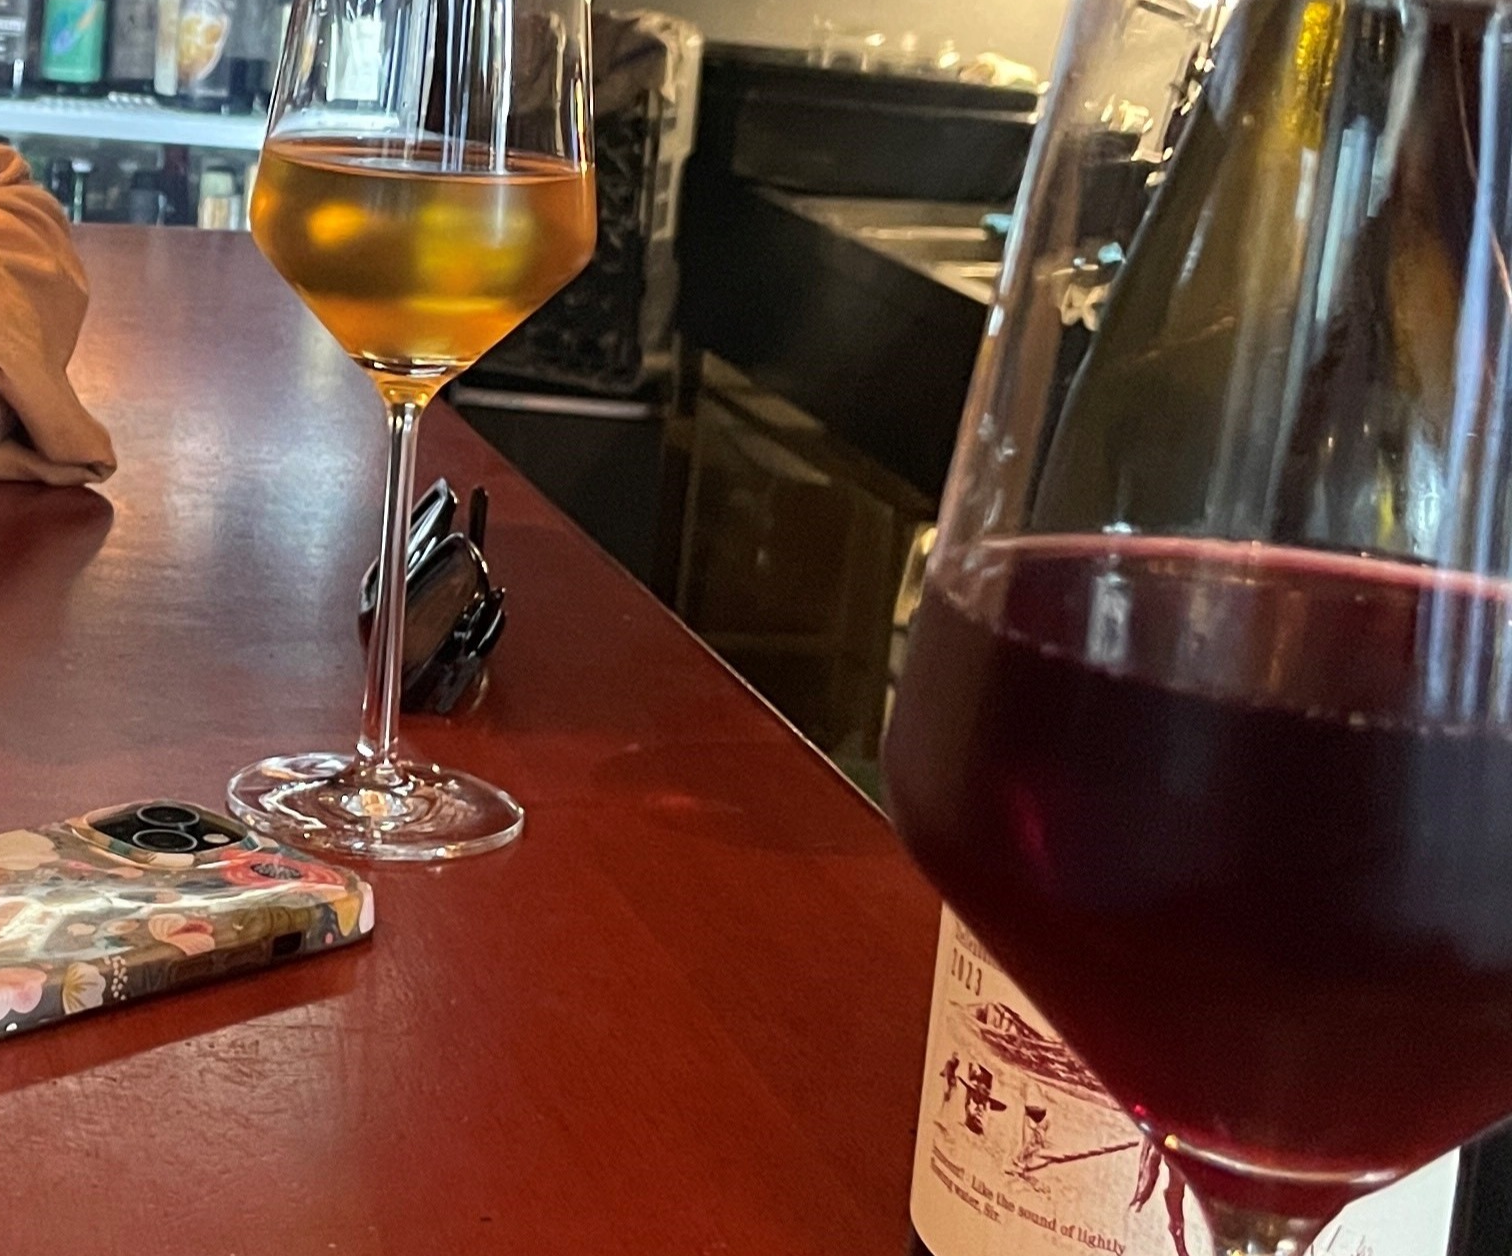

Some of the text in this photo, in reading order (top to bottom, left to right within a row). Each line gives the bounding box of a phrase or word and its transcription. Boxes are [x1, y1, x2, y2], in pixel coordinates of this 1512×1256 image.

[1018, 1206, 1057, 1233] sound
[1060, 1224, 1076, 1239] of
[1077, 1226, 1126, 1256] lightly
